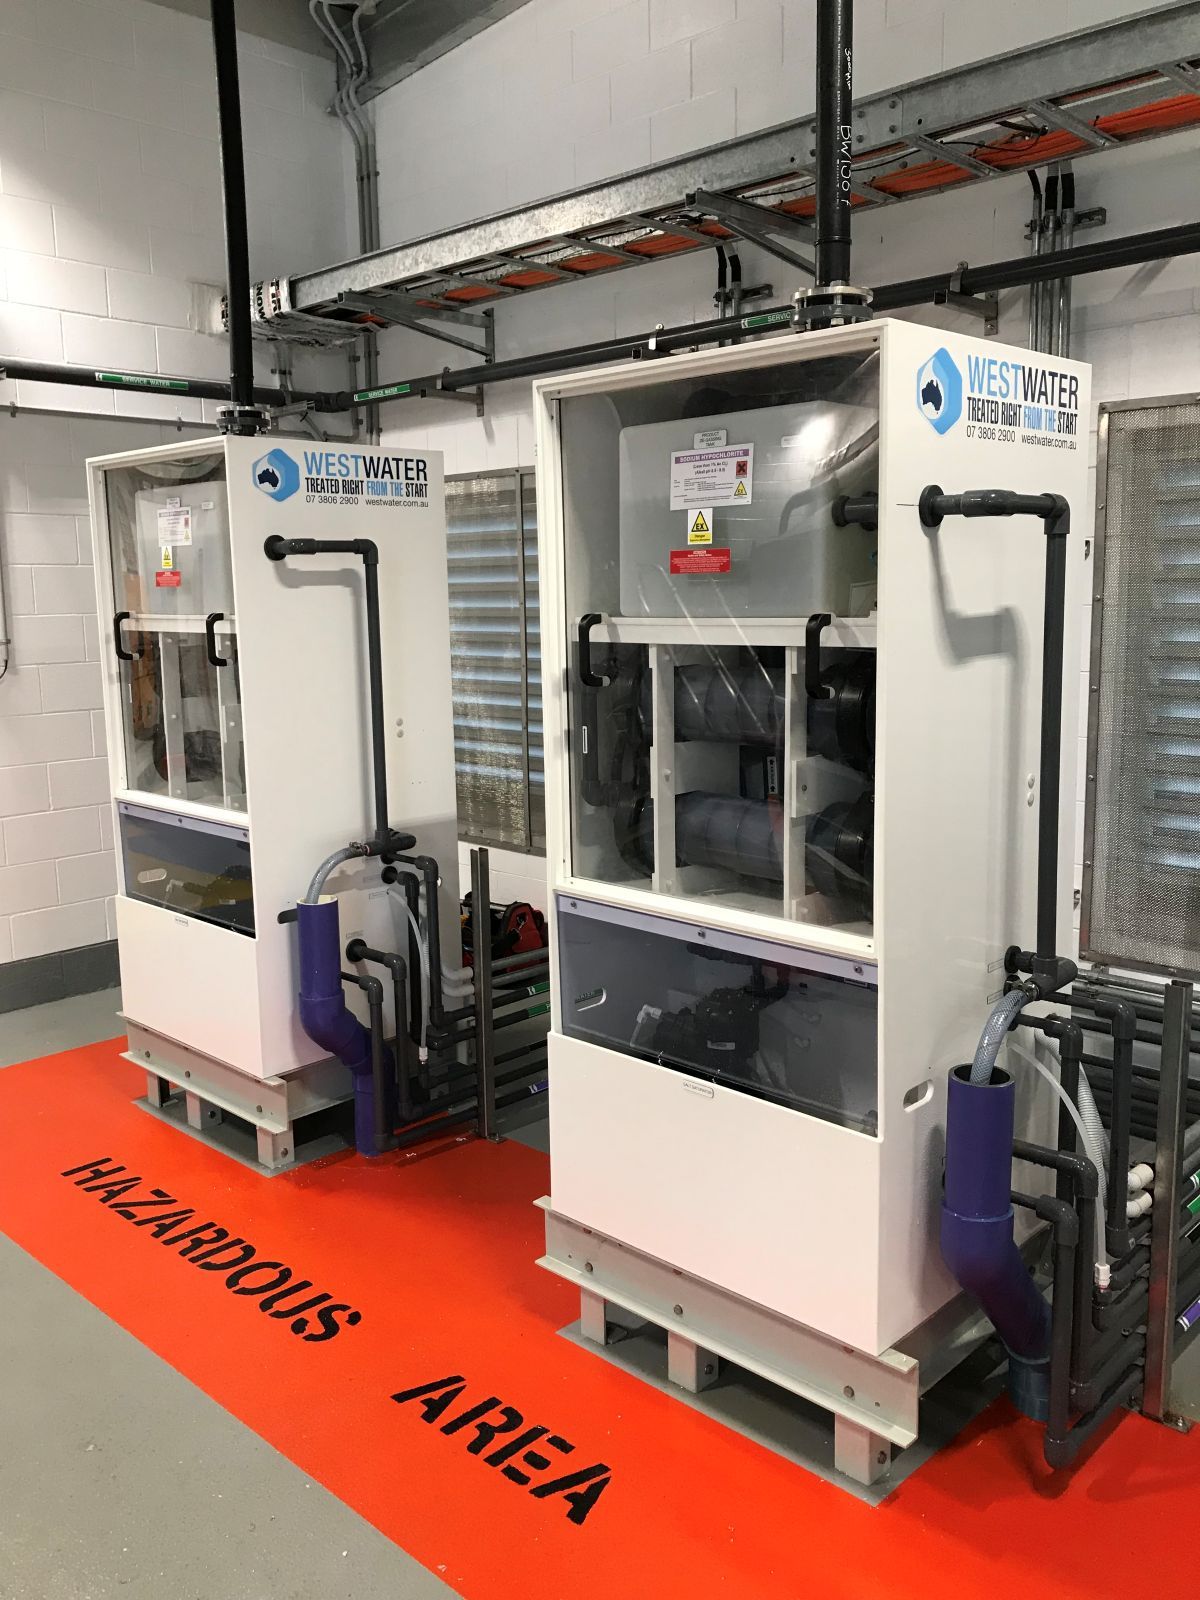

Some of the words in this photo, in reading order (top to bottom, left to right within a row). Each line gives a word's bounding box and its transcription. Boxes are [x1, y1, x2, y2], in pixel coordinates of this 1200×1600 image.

[767, 311, 791, 321] SERVIC
[968, 354, 1079, 410] WESTWATER
[967, 396, 999, 425] TREATED
[1001, 401, 1022, 428] RIGHT
[1023, 405, 1043, 431] FROM
[1044, 408, 1057, 433] THE
[1057, 410, 1078, 436] START
[966, 425, 976, 438] 07
[977, 426, 996, 440] 3806
[998, 429, 1016, 443] 2900
[1021, 434, 1077, 450] westwater.com.au
[303, 451, 428, 482] WESTWATER
[679, 455, 701, 463] SODIUM
[701, 450, 744, 460] HYPOCHLORITE
[305, 477, 340, 494] TREATED
[342, 479, 364, 495] RIGHT
[366, 480, 388, 497] FROM
[389, 481, 404, 497] THE
[405, 483, 428, 498] START
[305, 495, 316, 504] 07
[318, 495, 338, 505] 3806
[339, 496, 359, 505] 2900
[365, 498, 429, 508] westwater.com.au
[61, 1157, 362, 1342] HAZARDOUS
[390, 1375, 612, 1526] AREA
